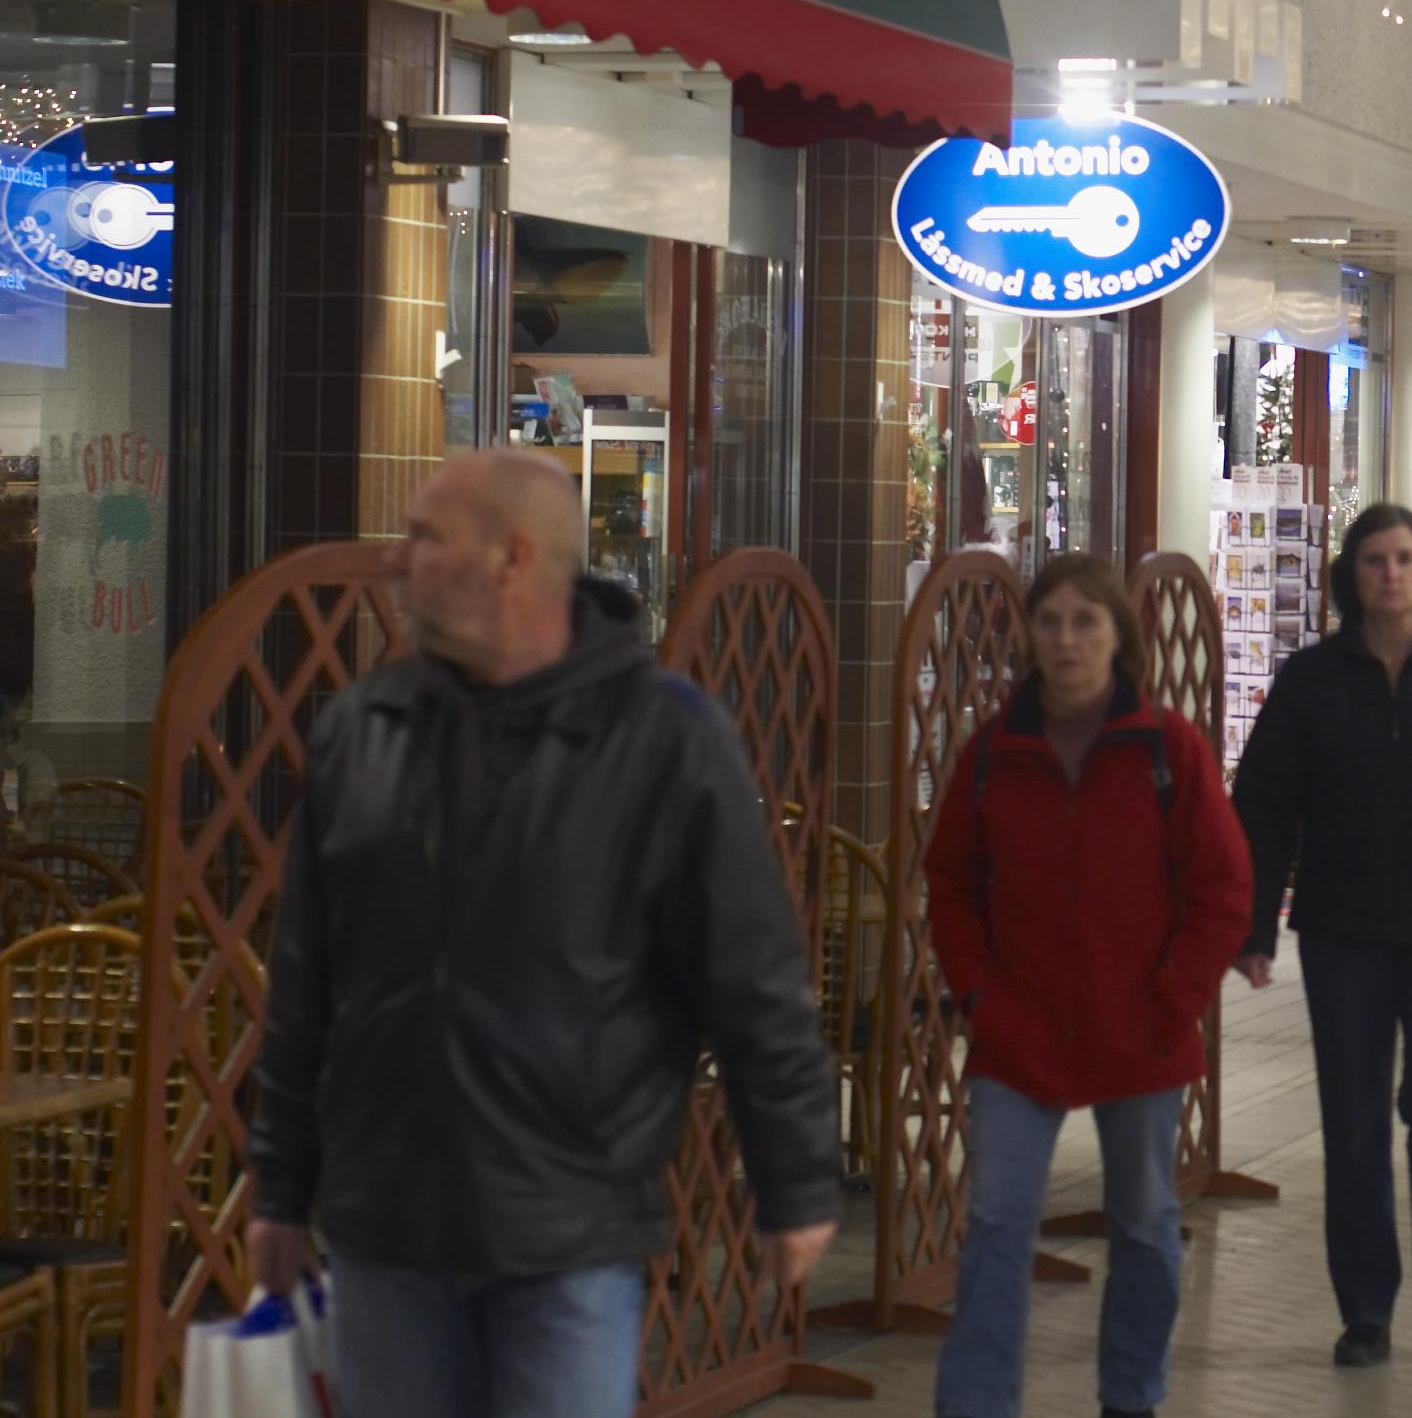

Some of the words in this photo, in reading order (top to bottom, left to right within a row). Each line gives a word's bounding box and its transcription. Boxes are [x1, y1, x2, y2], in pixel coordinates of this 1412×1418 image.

[972, 134, 1150, 176] Antonio
[910, 217, 1025, 297] Låssmed
[1030, 271, 1056, 301] &
[1063, 218, 1212, 301] Skoservice
